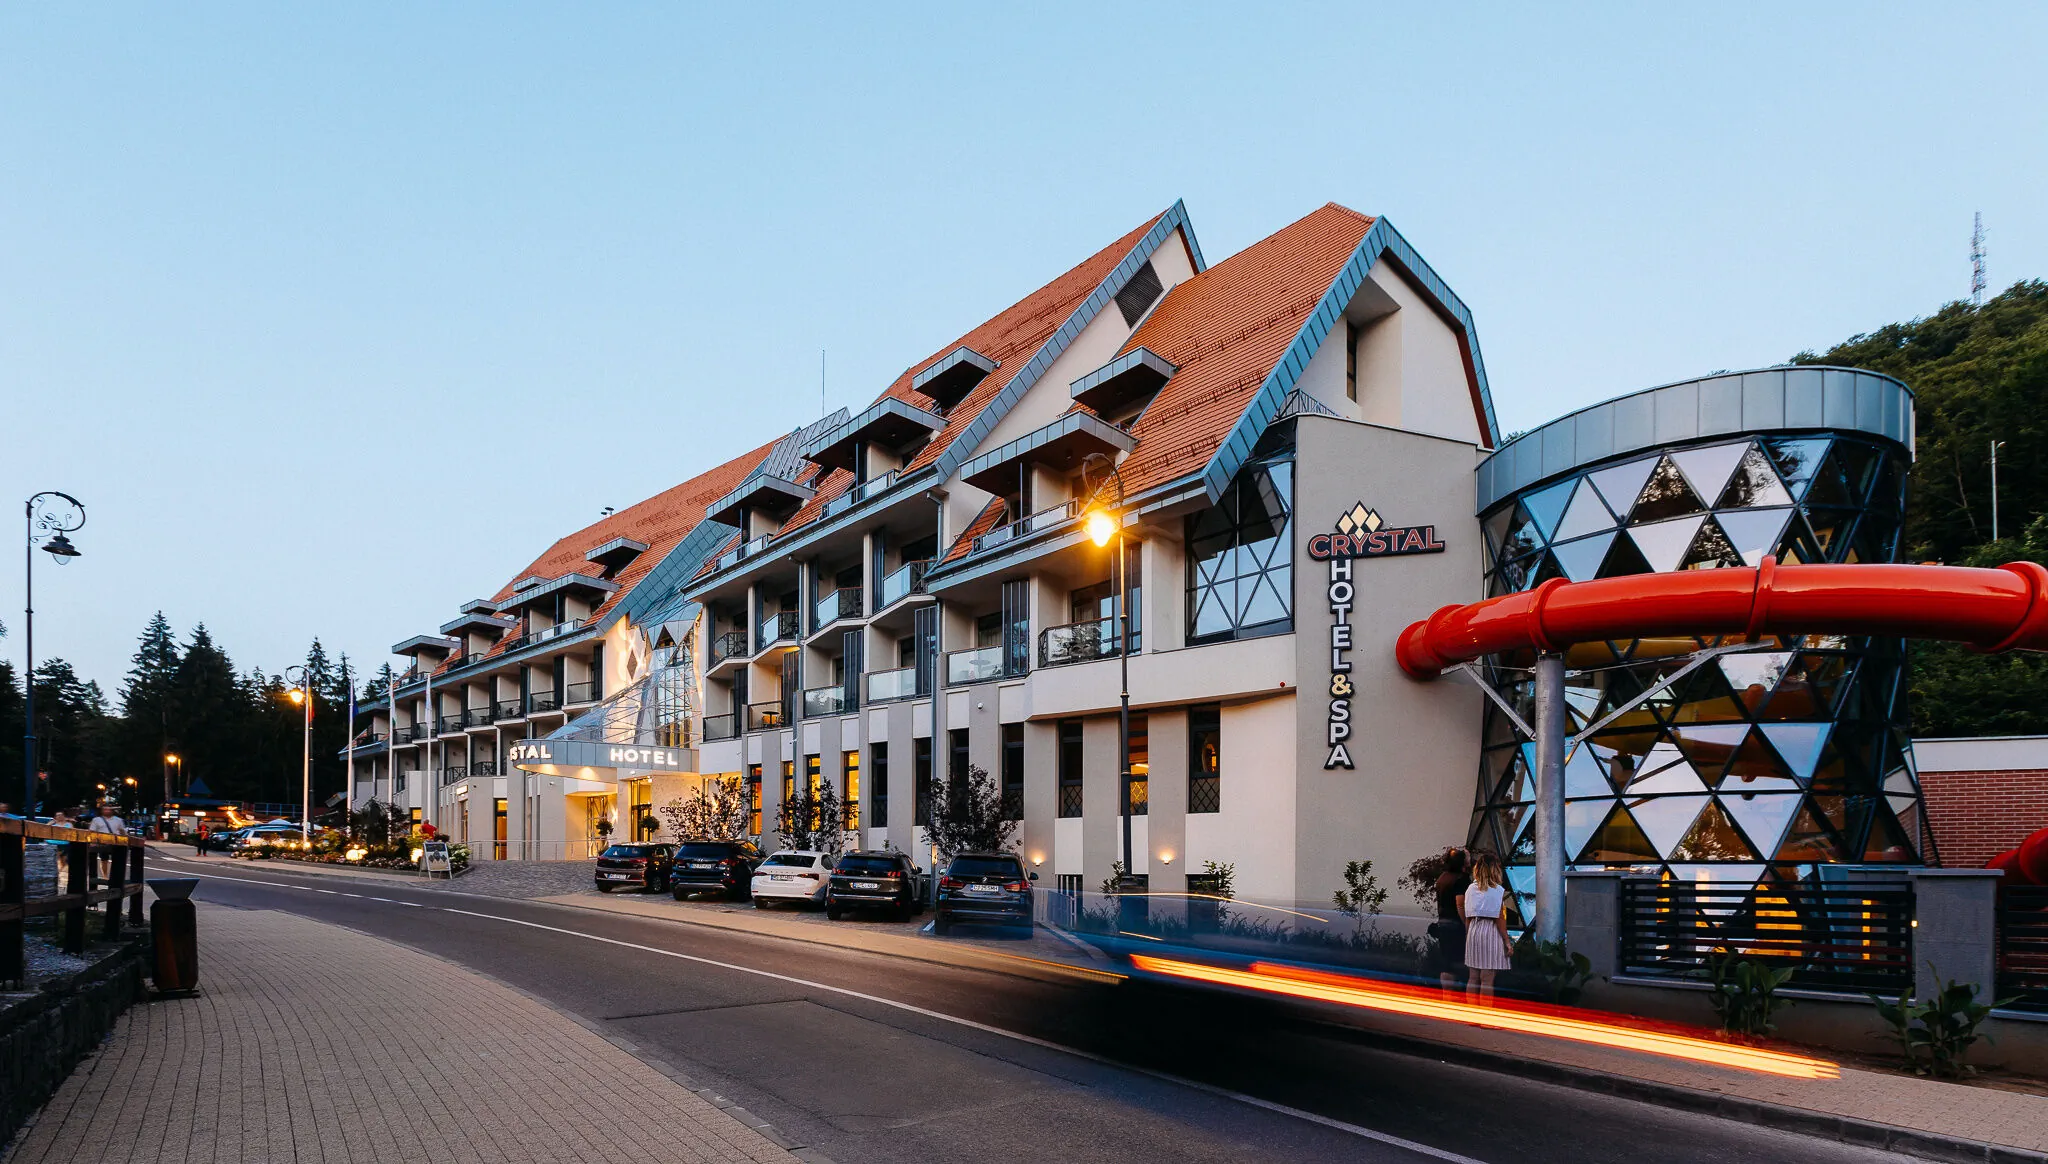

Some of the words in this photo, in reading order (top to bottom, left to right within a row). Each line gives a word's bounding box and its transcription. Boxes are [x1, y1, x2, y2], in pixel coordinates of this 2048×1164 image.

[1309, 527, 1444, 557] CRYSTAL
[1329, 559, 1354, 670] HOTEL
[1331, 673, 1352, 696] &
[1327, 700, 1351, 766] SPA
[610, 748, 678, 766] HOTEL
